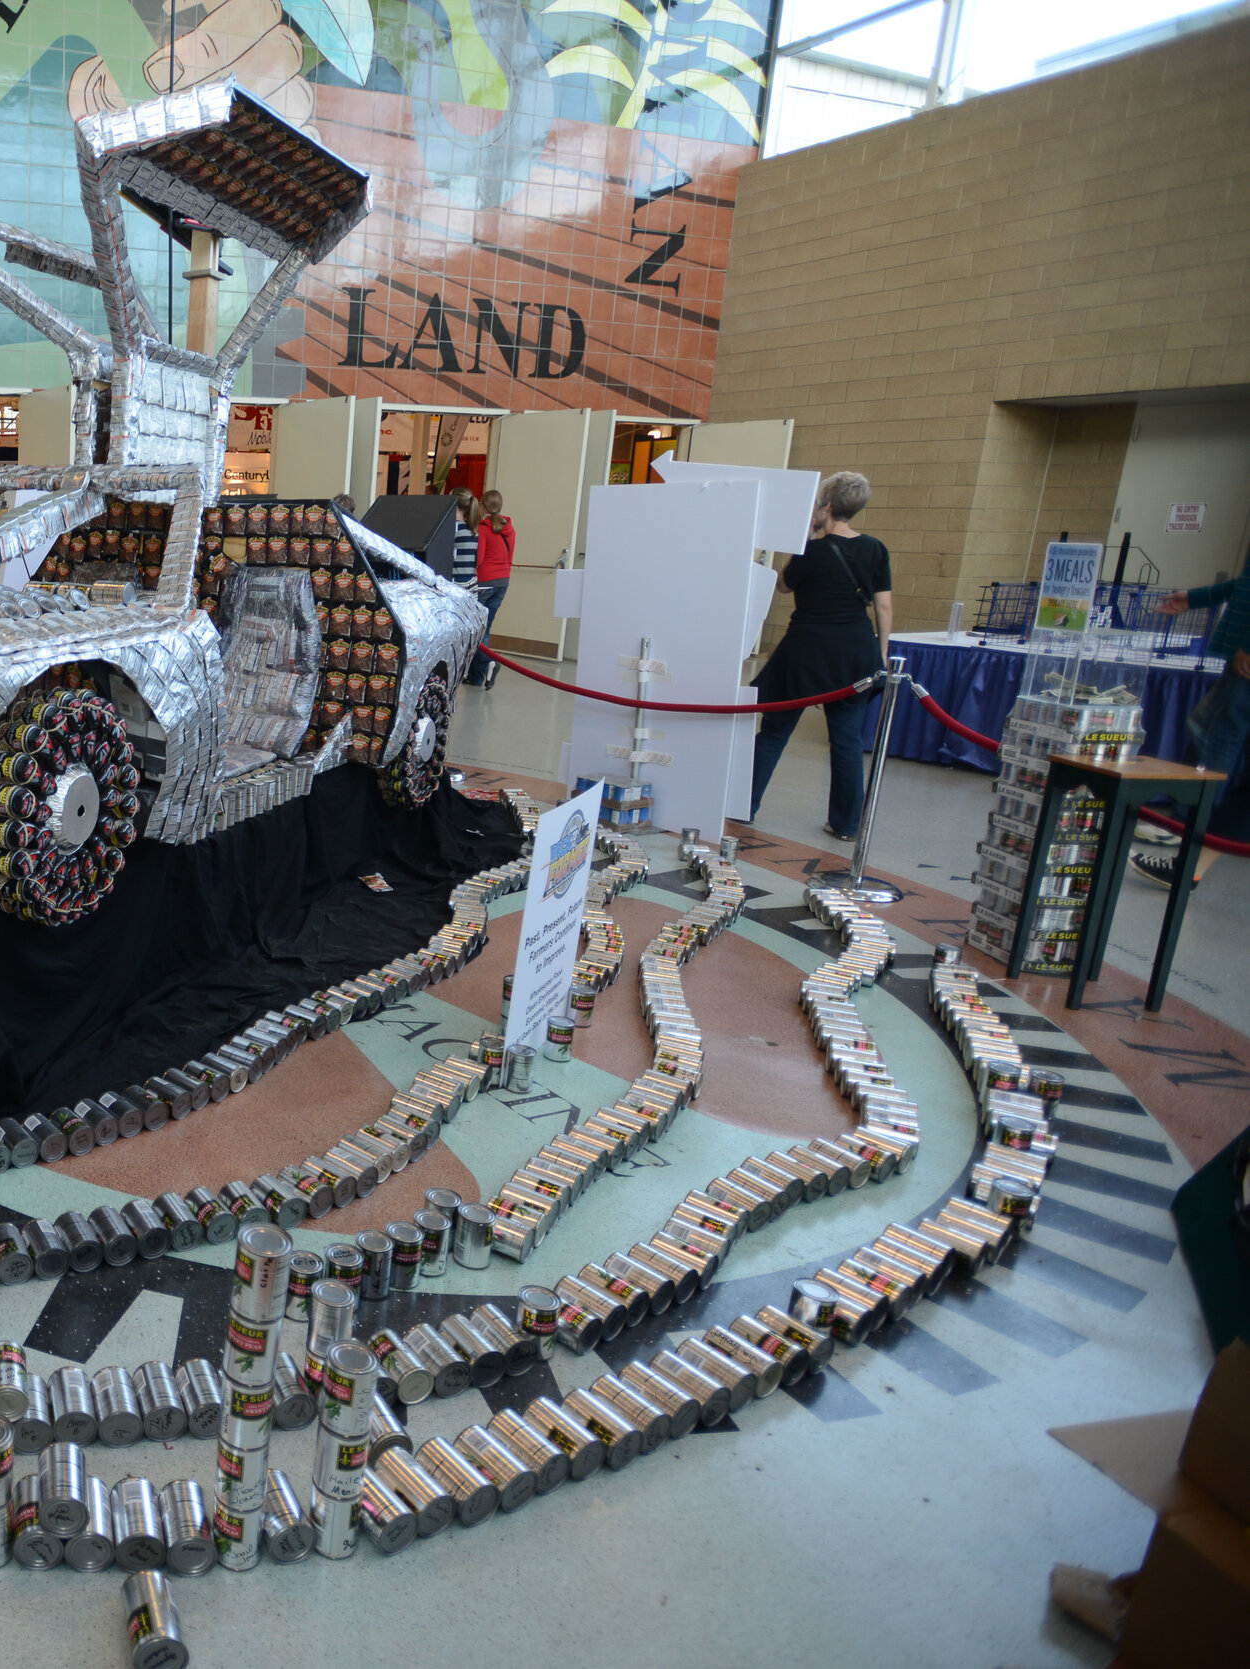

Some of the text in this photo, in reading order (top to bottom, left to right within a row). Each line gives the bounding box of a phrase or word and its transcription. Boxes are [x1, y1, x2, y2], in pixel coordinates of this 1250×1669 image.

[338, 287, 586, 380] LAND
[1046, 558, 1094, 583] 3 MEALS
[1100, 733, 1133, 741] SUEUR
[554, 918, 577, 943] Continue
[235, 1393, 249, 1401] LE
